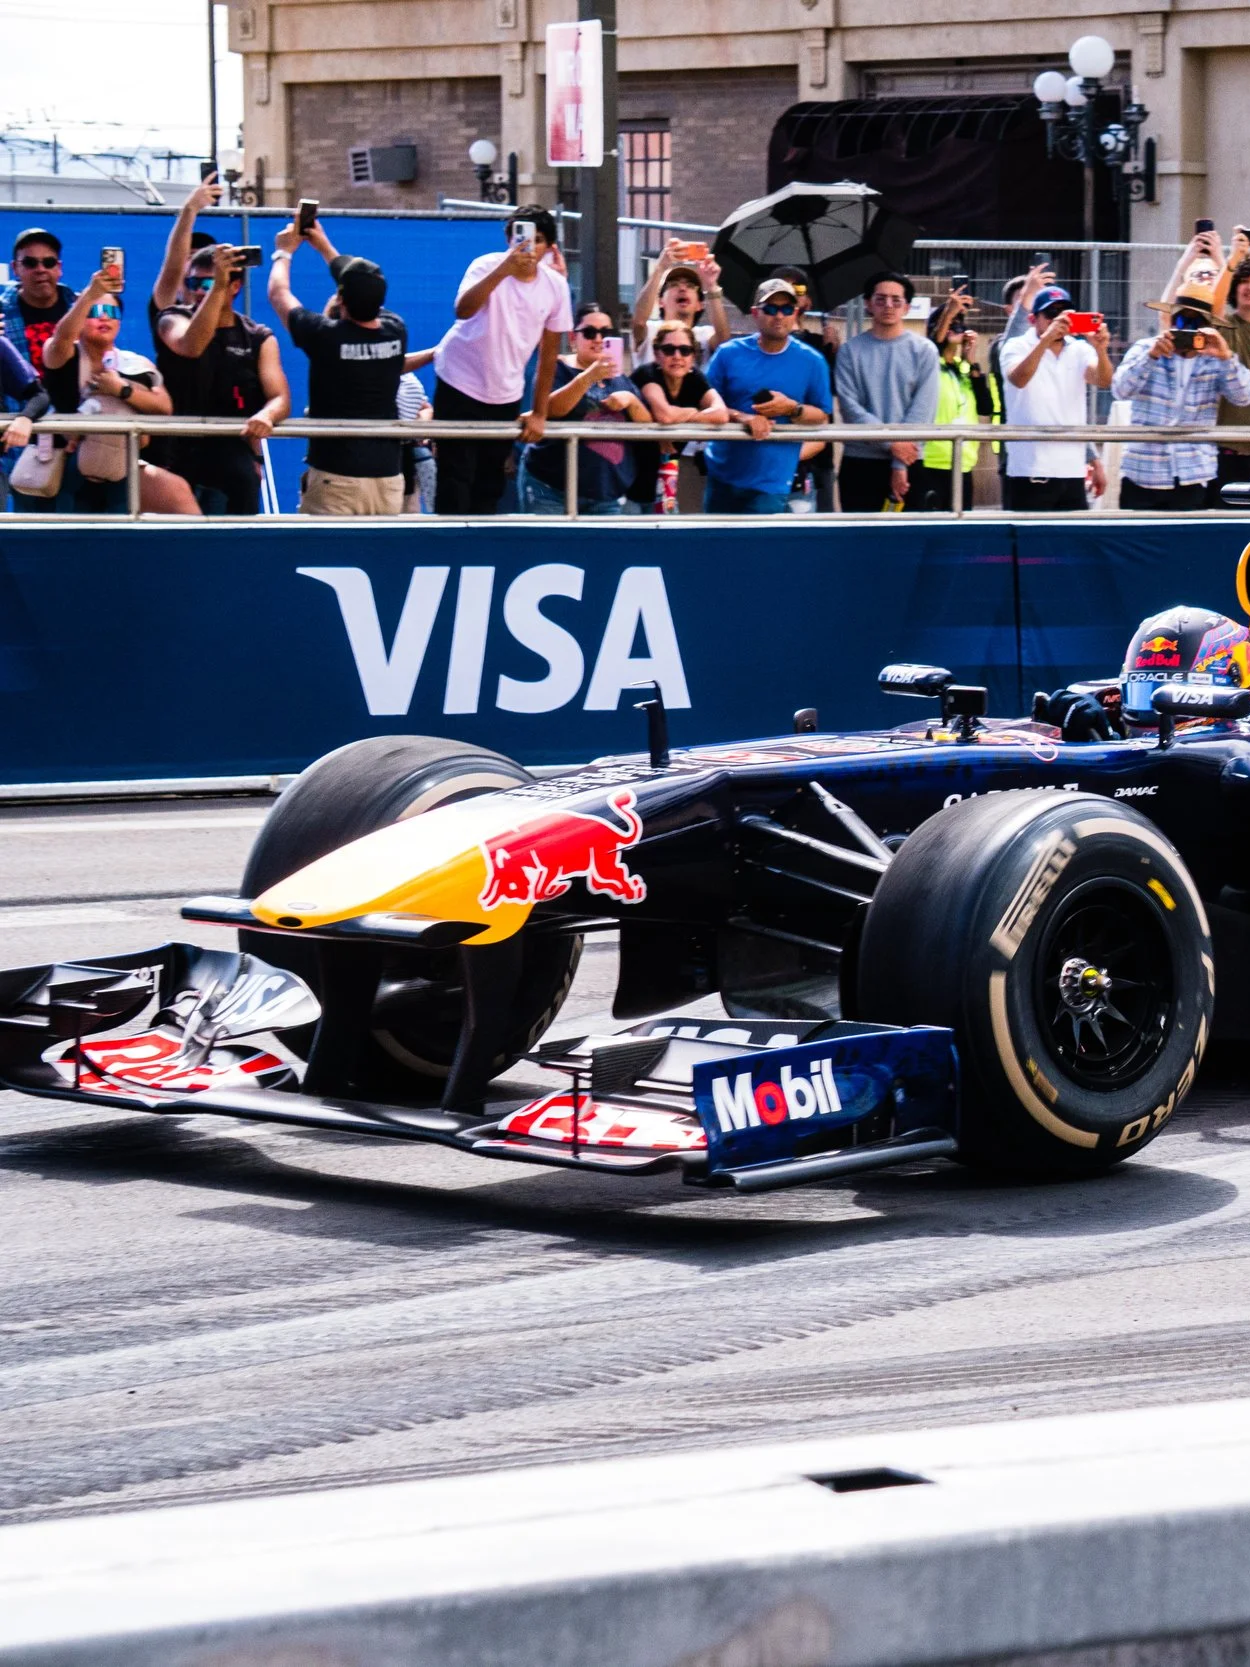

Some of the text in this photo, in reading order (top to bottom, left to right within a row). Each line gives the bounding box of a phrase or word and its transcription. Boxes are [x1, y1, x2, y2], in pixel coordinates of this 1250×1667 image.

[296, 563, 692, 716] VISA
[1129, 672, 1184, 683] ORACLE
[1171, 691, 1214, 705] VISA
[1114, 786, 1159, 797] DAMAC
[210, 974, 310, 1027] VISA
[711, 1058, 842, 1133] Mobil
